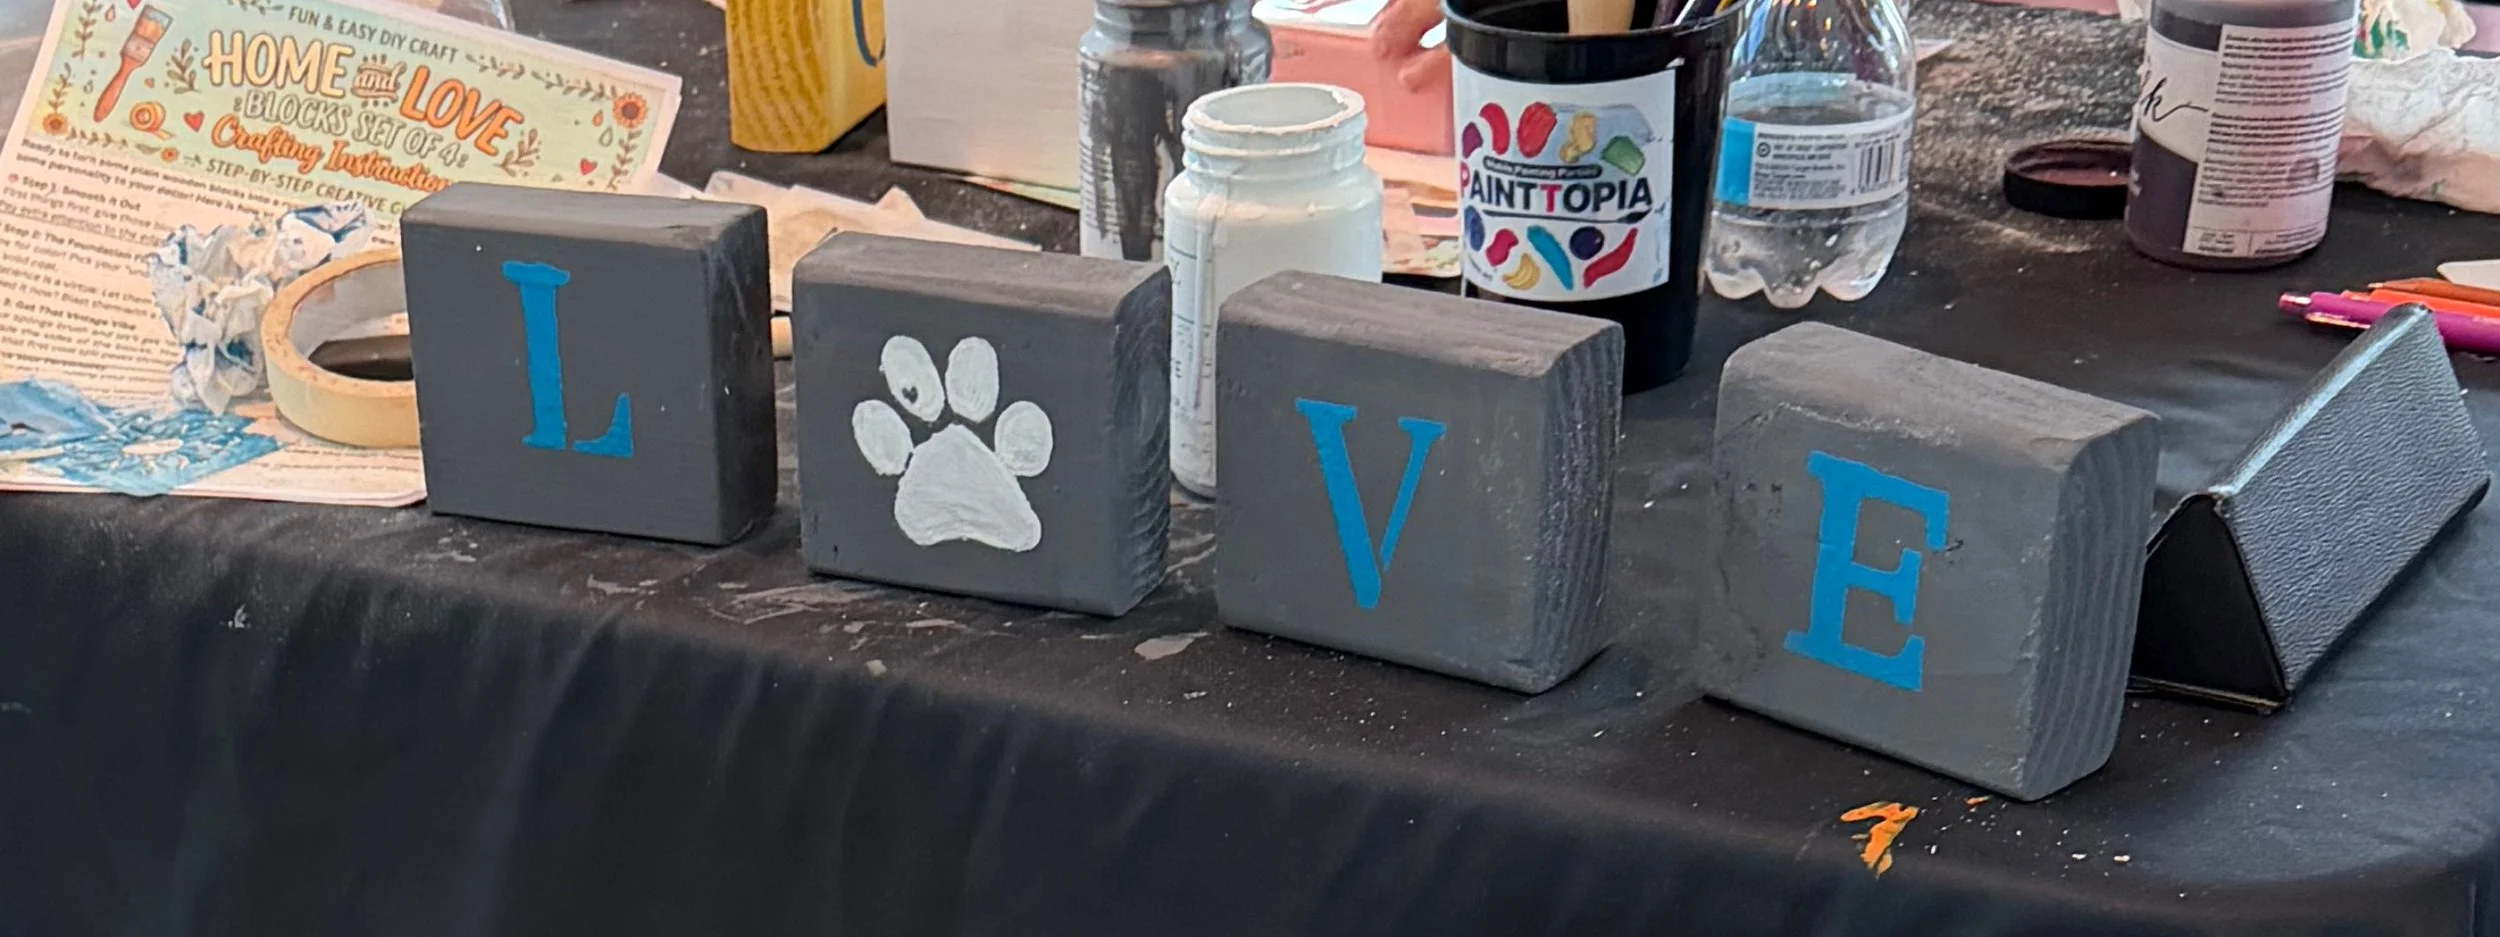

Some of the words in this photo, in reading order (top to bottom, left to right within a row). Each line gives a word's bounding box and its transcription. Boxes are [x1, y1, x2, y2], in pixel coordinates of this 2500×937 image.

[289, 6, 320, 26] FUN
[323, 15, 334, 31] &
[338, 19, 377, 42] EASY
[380, 30, 408, 49] DIY
[410, 37, 459, 63] CRAFT
[201, 29, 355, 99] HOME
[353, 61, 407, 101] and
[399, 64, 525, 157] LOVE
[243, 89, 352, 137] BLOCKS
[352, 110, 406, 150] SET
[403, 126, 443, 159] OF
[22, 175, 49, 191] Step
[211, 113, 325, 175] Crafting
[322, 139, 453, 193] Instruction
[206, 158, 314, 194] STEP-BY-STEP
[315, 183, 389, 213] CREATIVE
[1461, 161, 1654, 213] PAINTTOPIA
[501, 261, 632, 459] L
[1295, 400, 1444, 609] V
[1787, 452, 1949, 691] E
